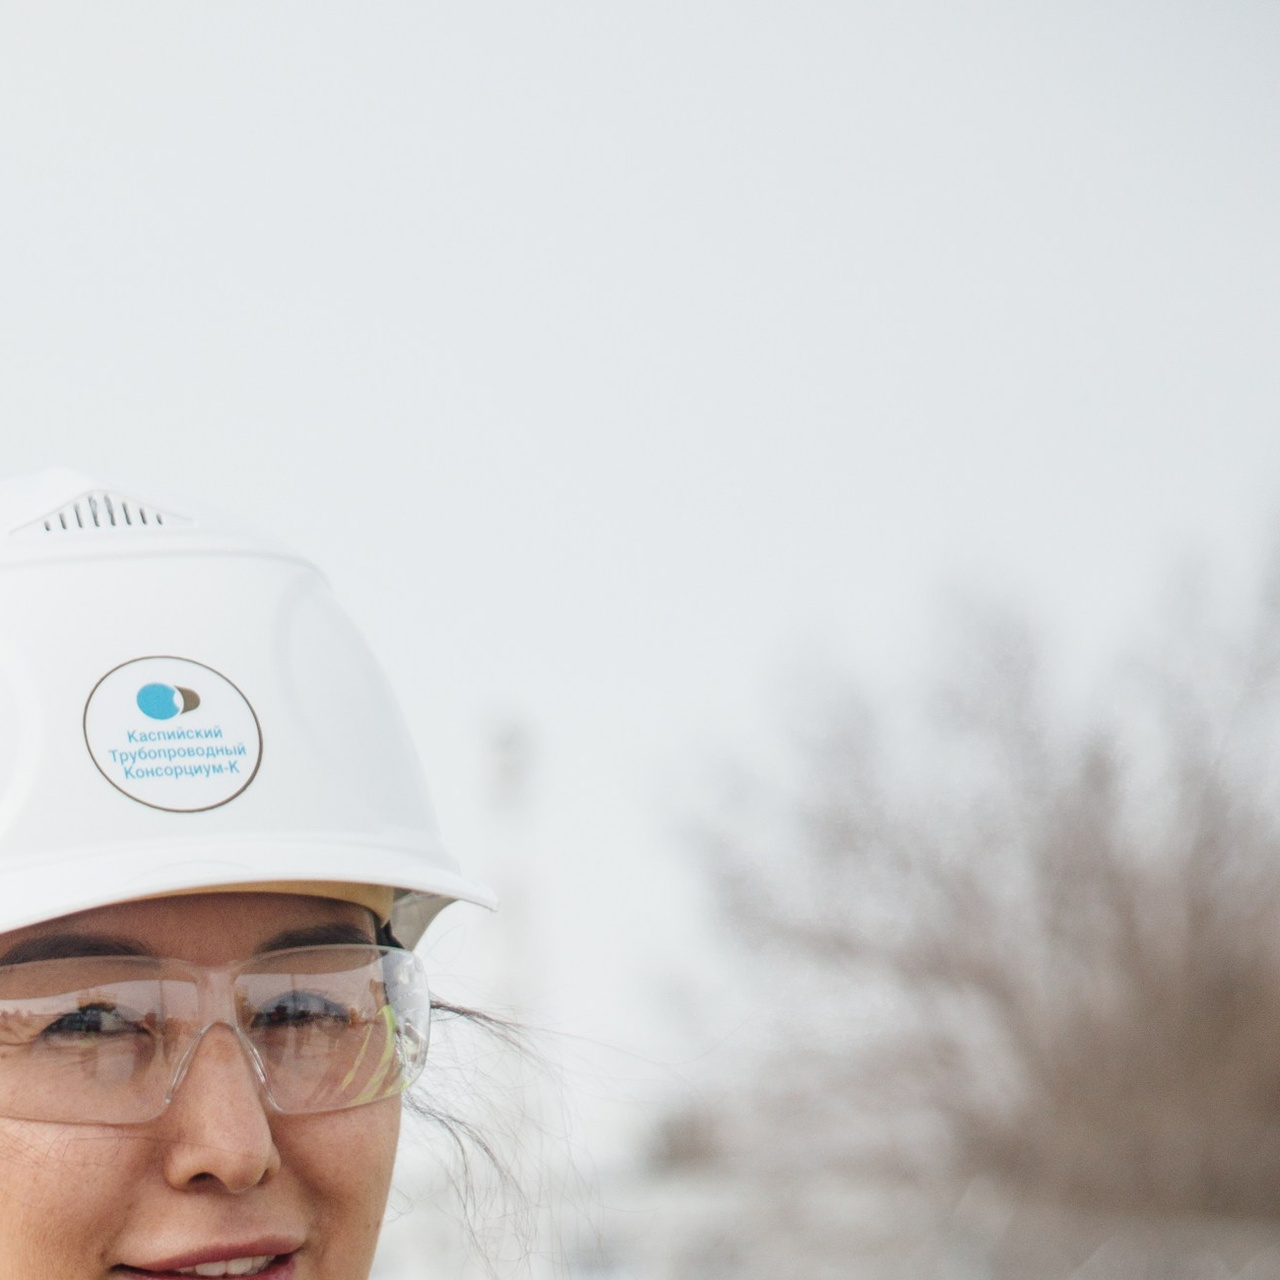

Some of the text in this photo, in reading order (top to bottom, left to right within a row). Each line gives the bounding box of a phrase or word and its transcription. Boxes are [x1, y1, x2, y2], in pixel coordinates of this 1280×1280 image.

[127, 725, 223, 743] Каспийский
[109, 743, 246, 765] Трубопроводный
[124, 761, 240, 779] Консорциум-К
